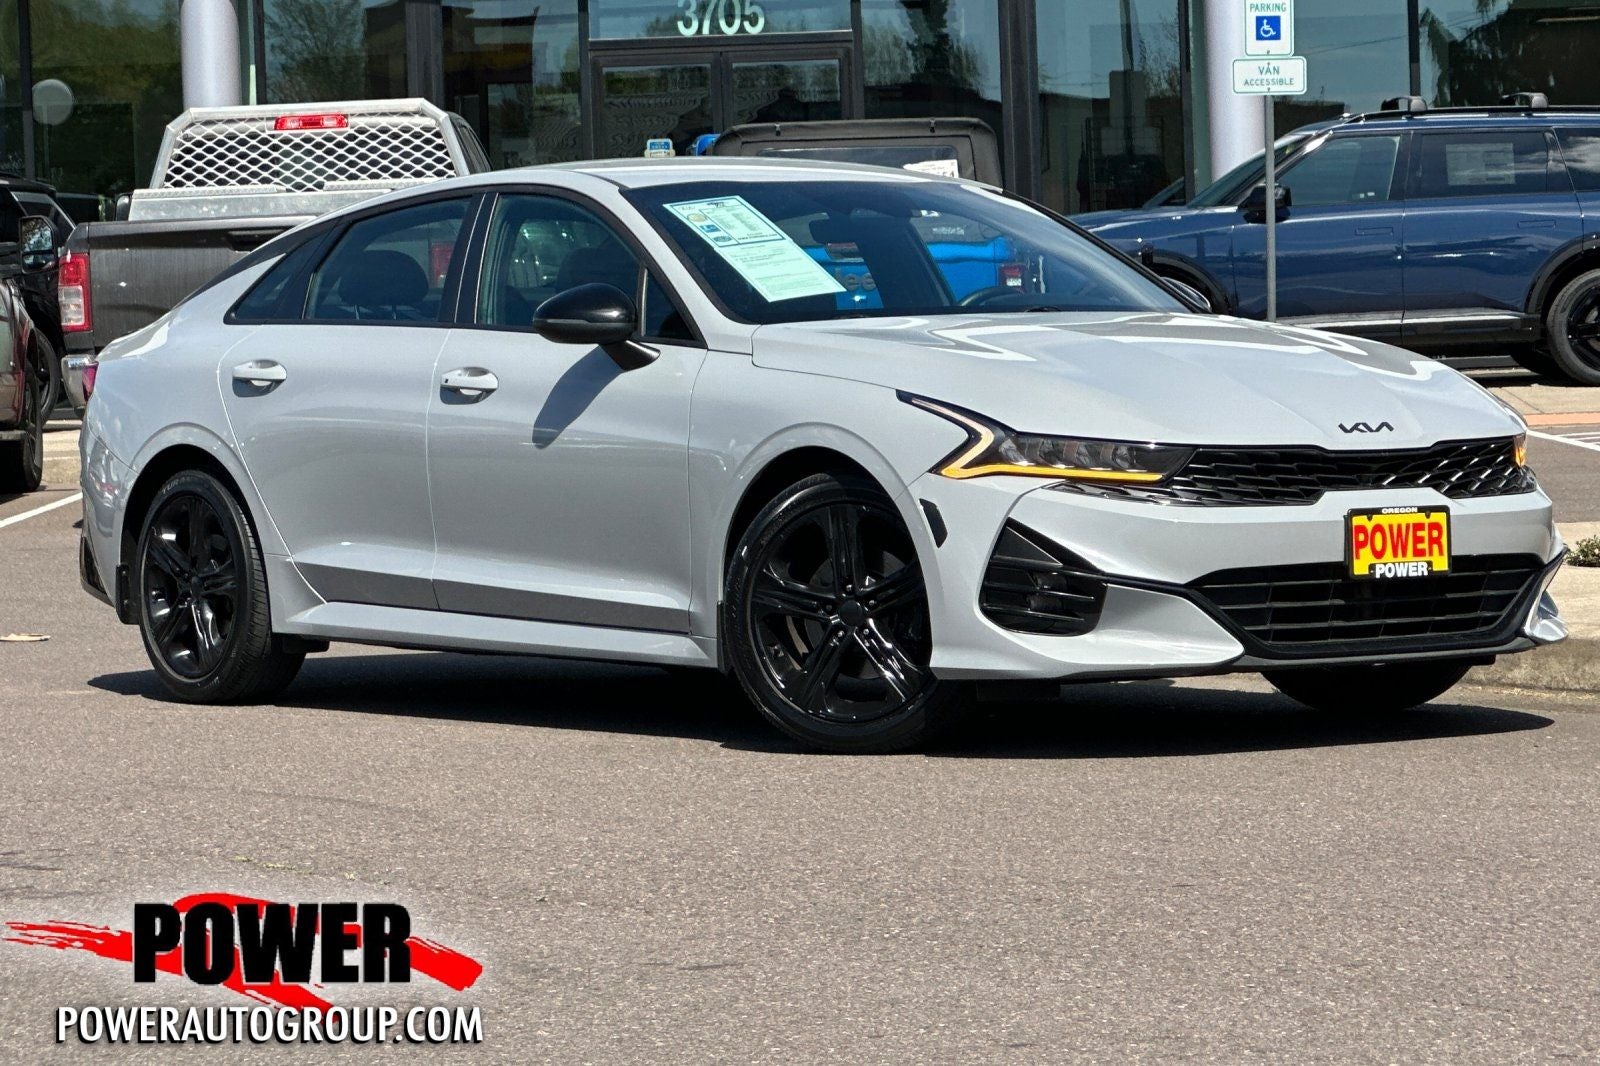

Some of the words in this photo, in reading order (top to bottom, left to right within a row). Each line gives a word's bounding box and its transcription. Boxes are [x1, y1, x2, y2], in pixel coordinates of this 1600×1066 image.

[1249, 3, 1287, 12] PARKING
[677, 0, 765, 36] 3705
[1258, 66, 1280, 75] VAN
[1243, 78, 1295, 86] ACCESSIBLE
[1338, 421, 1394, 433] KIA
[1381, 506, 1418, 514] OREGON
[1354, 521, 1444, 561] POWER
[1375, 561, 1429, 579] POWER
